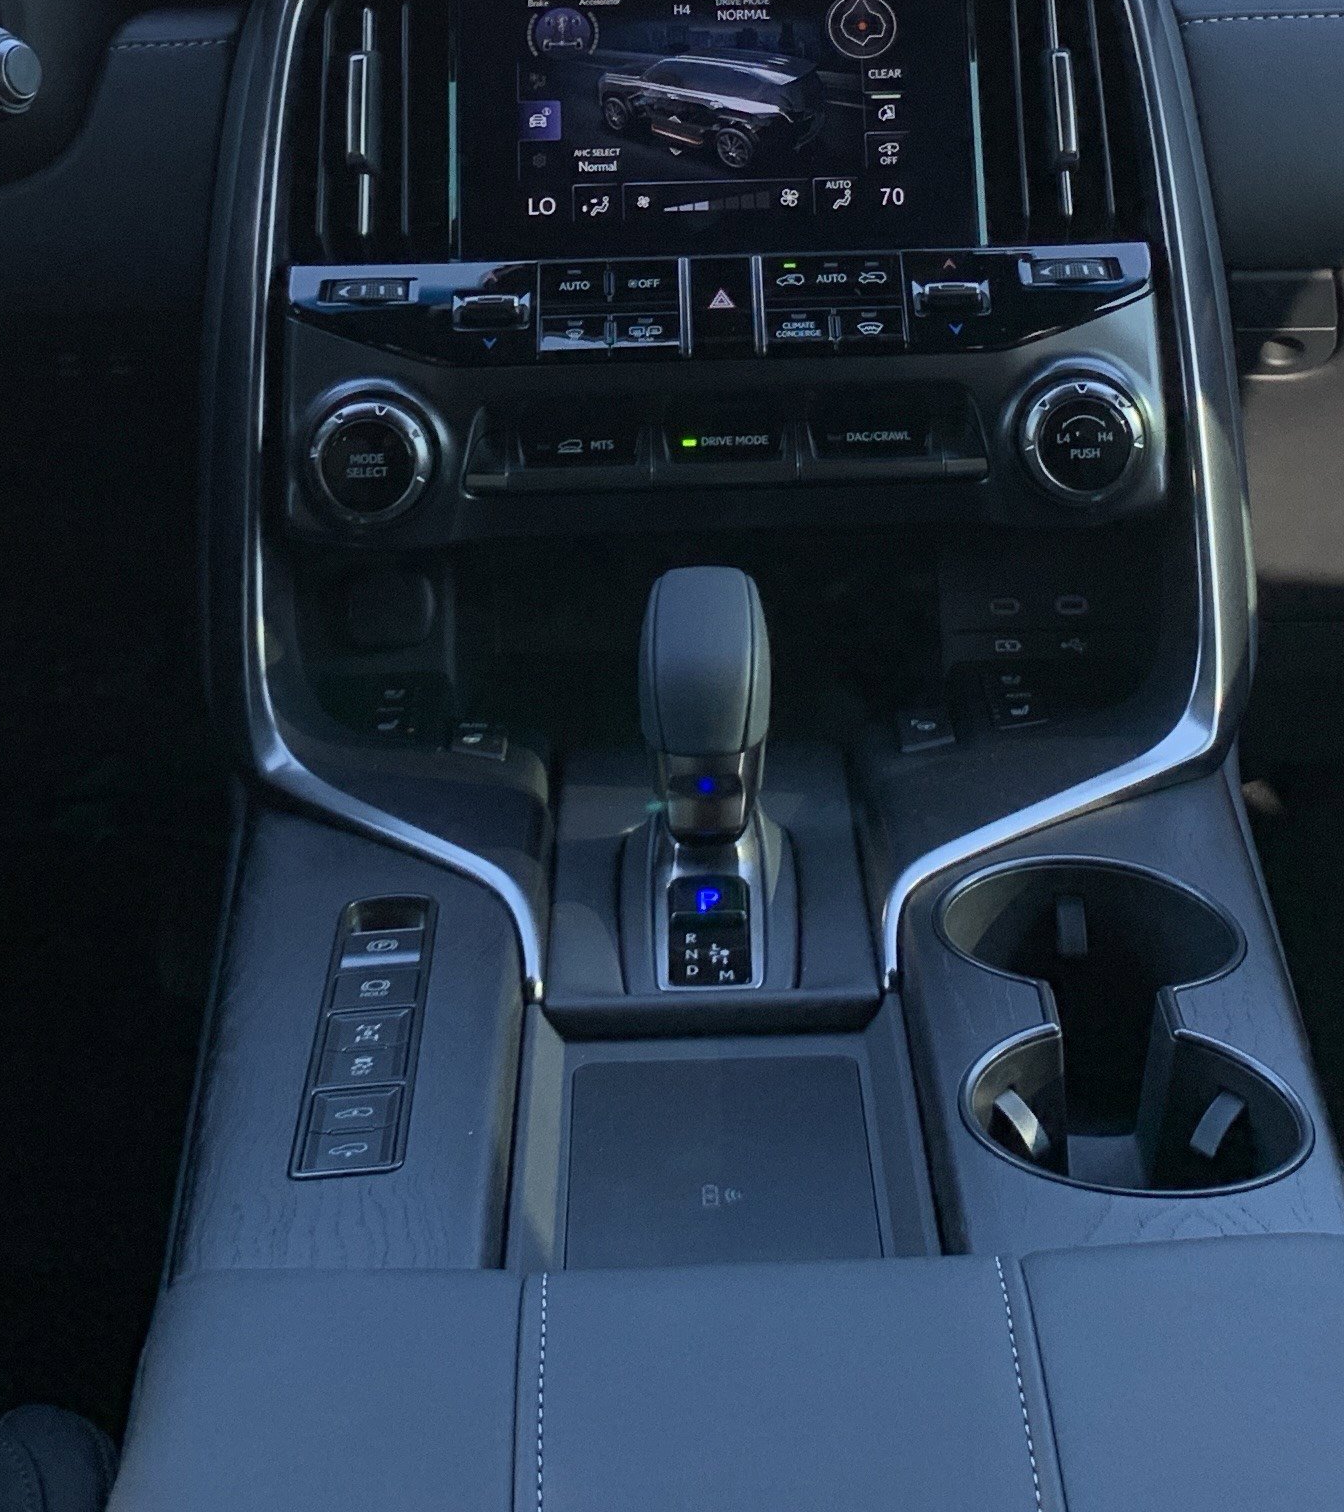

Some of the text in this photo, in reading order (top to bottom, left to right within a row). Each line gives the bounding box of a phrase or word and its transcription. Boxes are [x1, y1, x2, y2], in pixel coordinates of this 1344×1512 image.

[527, 0, 549, 7] Brake
[674, 5, 691, 15] H4
[717, 9, 770, 21] NORMAL
[868, 69, 902, 79] CLEAR
[574, 148, 621, 157] AHC SELECT
[880, 156, 898, 165] OFF
[578, 161, 617, 172] Normal
[825, 180, 851, 189] AUTO
[880, 187, 904, 205] 70
[528, 197, 556, 216] LO
[638, 278, 661, 288] OFF
[816, 274, 847, 283] AUTO
[559, 281, 590, 291] AUTO
[782, 321, 815, 329] CLIMATE
[776, 329, 822, 338] CONCIERGE
[701, 435, 769, 446] DRIVE MODE
[846, 431, 911, 442] DAC/CRAWL
[1056, 431, 1113, 444] L4 H4
[590, 439, 615, 450] MTS
[350, 453, 385, 464] MODE
[1070, 448, 1101, 459] PUSH
[346, 466, 388, 478] SELECT
[700, 891, 718, 910] P
[685, 933, 696, 944] R
[685, 949, 698, 959] N
[686, 965, 699, 975] D
[719, 970, 735, 981] M
